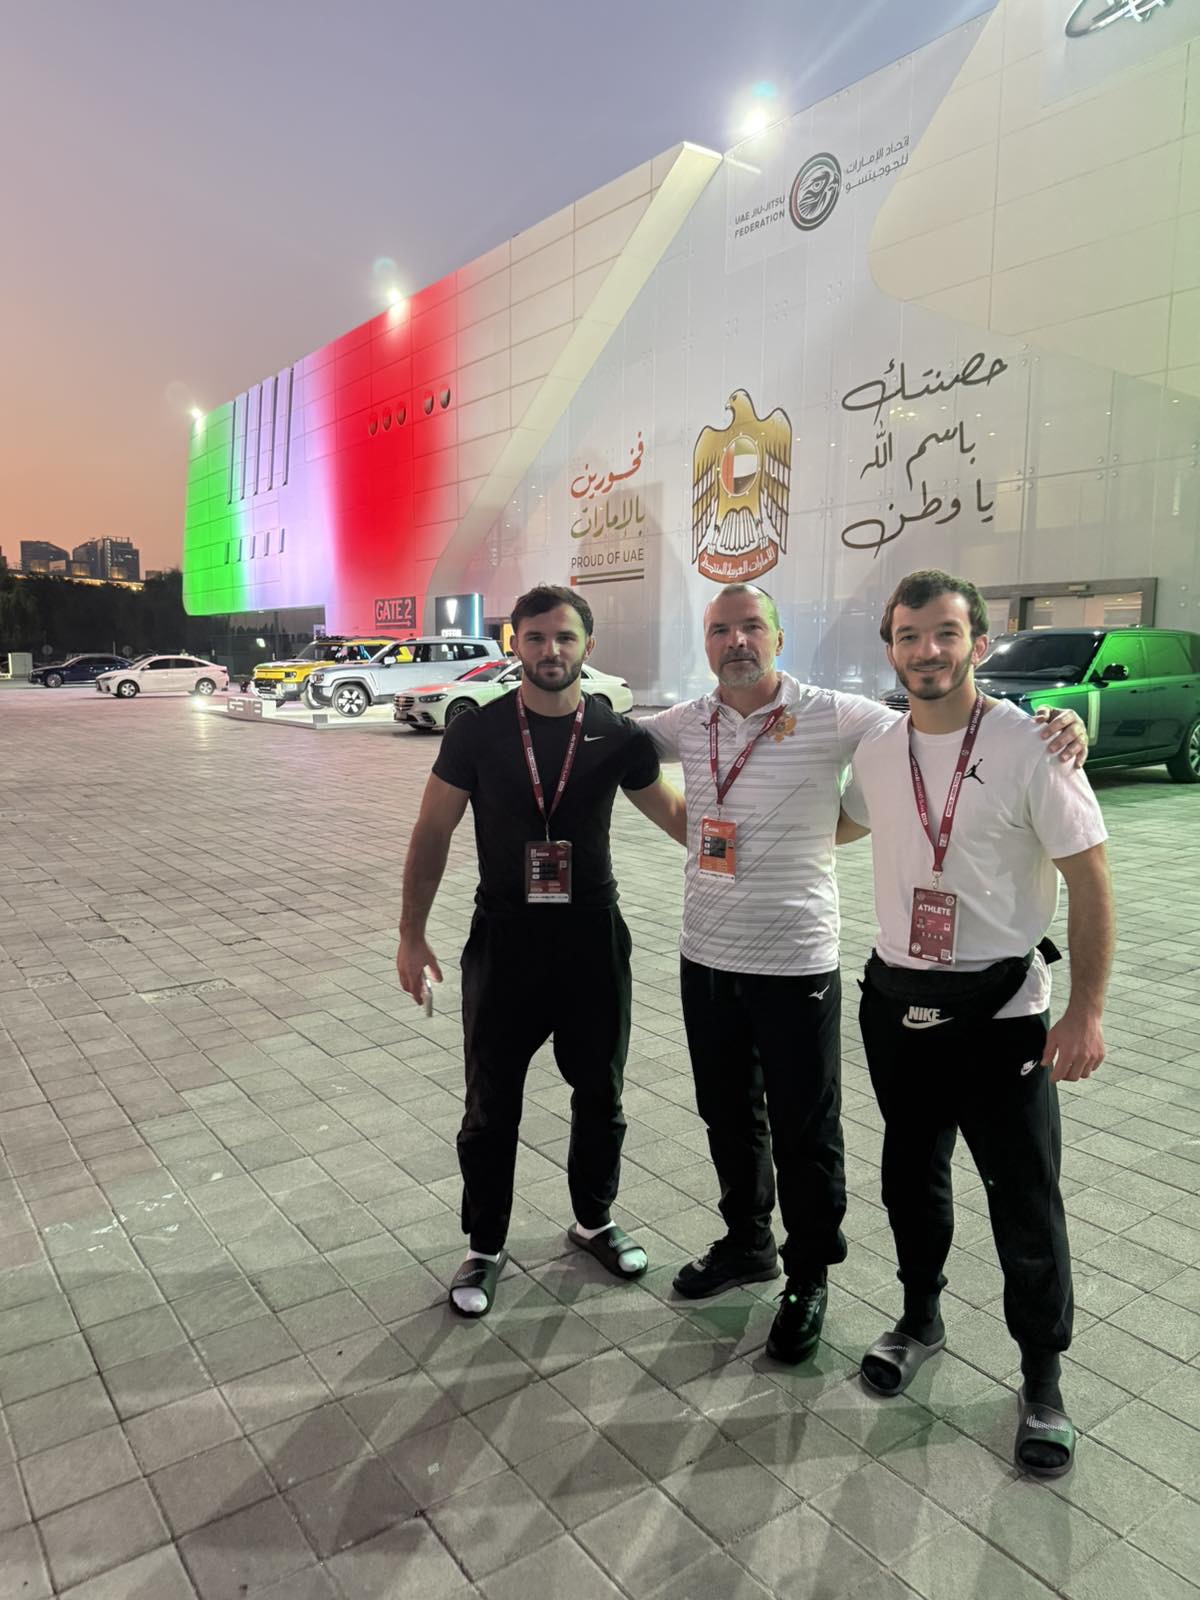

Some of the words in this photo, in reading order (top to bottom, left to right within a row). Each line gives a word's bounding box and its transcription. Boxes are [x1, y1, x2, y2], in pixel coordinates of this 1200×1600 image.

[734, 210, 750, 225] UAE
[750, 194, 785, 219] JIU-JITSU
[734, 209, 785, 239] FEDERATION
[570, 553, 605, 569] PROUD
[606, 551, 621, 566] OF
[623, 547, 645, 563] UAE
[376, 600, 402, 621] GATE
[404, 599, 412, 619] 2
[918, 903, 951, 917] ATHLETE
[907, 1005, 941, 1022] NIKE
